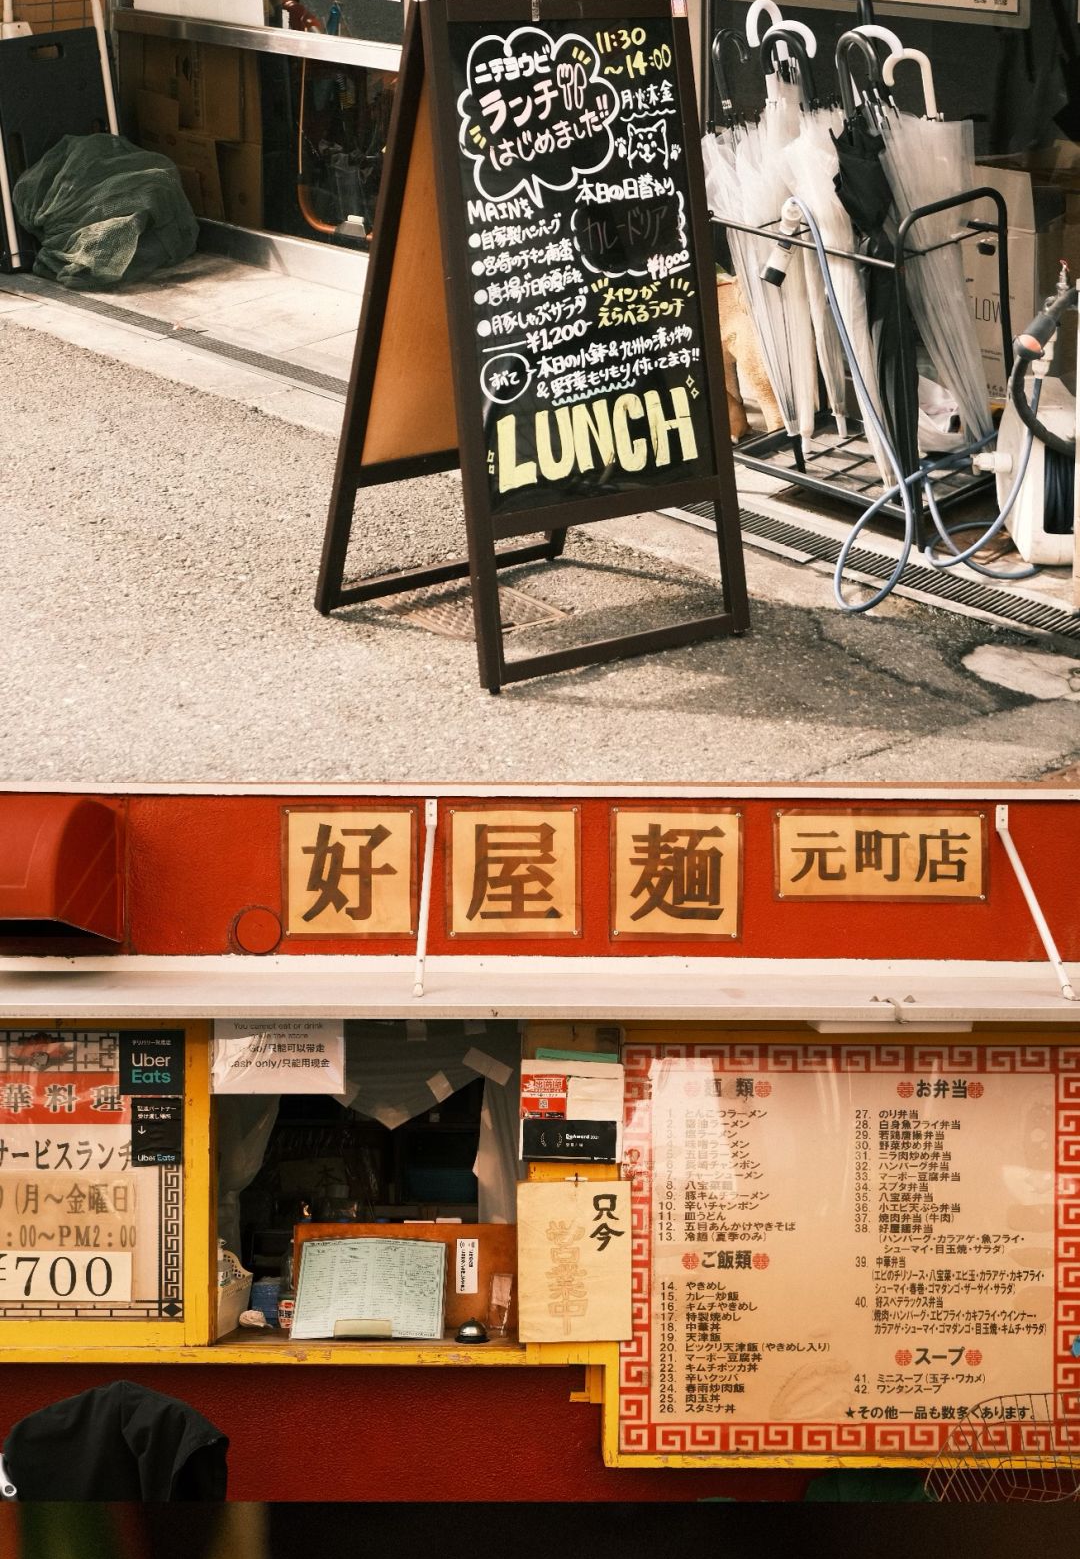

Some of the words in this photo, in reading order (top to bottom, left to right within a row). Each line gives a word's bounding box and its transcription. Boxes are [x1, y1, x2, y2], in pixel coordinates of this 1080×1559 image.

[595, 27, 646, 54] 11:30
[474, 44, 551, 85] ニチヨウビ
[479, 79, 558, 135] ランチ
[575, 173, 675, 206] 本日の日替わり
[467, 198, 522, 225] MAIN
[582, 206, 668, 255] カレードリア
[484, 237, 575, 277] 宮崎のチキン南蛮
[487, 264, 584, 307] 唐揚げ日向夏だれ
[602, 281, 663, 306] メインが
[491, 285, 589, 336] 豚しゃぶサラダ
[597, 297, 686, 329] えらべるランチ
[497, 386, 699, 494] LUNCH
[790, 829, 973, 883] 元町店
[250, 1022, 276, 1030] cannot
[304, 1022, 323, 1030] drink
[131, 1052, 172, 1067] Uber
[231, 1059, 252, 1068] ash
[256, 1058, 331, 1069] only/只能用现金
[131, 1069, 172, 1084] Eats
[916, 1079, 968, 1099] お弁当
[855, 1110, 871, 1119] 27.
[879, 1110, 919, 1119] のり弁当
[855, 1120, 871, 1130] 28.
[880, 1120, 960, 1130] 白身魚フライ弁当
[855, 1131, 871, 1140] 29.
[855, 1141, 871, 1150] 30.
[879, 1141, 943, 1150] 野菜炒め弁当
[137, 1154, 156, 1162] Uber
[157, 1154, 176, 1162] Eats
[855, 1152, 871, 1161] 31.
[879, 1152, 951, 1161] ニラ肉炒め弁当
[855, 1162, 871, 1171] 32.
[879, 1162, 949, 1171] ハンバーグ弁当
[855, 1172, 871, 1182] 33.
[880, 1172, 960, 1182] マーボー豆腐弁当
[855, 1183, 871, 1192] 34.
[879, 1183, 929, 1192] スブタ弁当
[855, 1193, 871, 1202] 35.
[879, 1193, 933, 1202] 八宝菜弁当
[658, 1202, 676, 1210] 10.
[855, 1203, 871, 1213] 36.
[658, 1212, 676, 1220] 11.
[685, 1212, 726, 1220] 皿うどん
[855, 1214, 871, 1223] 37.
[589, 1193, 626, 1252] 只今
[658, 1222, 676, 1231] 12.
[685, 1222, 795, 1231] 五目あんかけやきそば
[855, 1224, 871, 1233] 38.
[658, 1233, 676, 1241] 13.
[701, 1250, 752, 1269] ご飯類
[855, 1257, 868, 1268] 39.
[875, 1257, 906, 1268] 中華弁当
[660, 1282, 677, 1290] 14.
[686, 1282, 726, 1290] やきめし
[660, 1292, 677, 1301] 15.
[855, 1296, 868, 1308] 40.
[660, 1303, 677, 1311] 16.
[686, 1303, 758, 1311] キムチやきめし
[660, 1313, 677, 1321] 17.
[686, 1313, 741, 1321] 特製焼めし
[660, 1323, 677, 1332] 18.
[686, 1323, 721, 1332] 中華丼
[660, 1333, 677, 1342] 19.
[686, 1333, 720, 1342] 天津飯
[660, 1343, 677, 1352] 20.
[660, 1353, 677, 1362] 21.
[686, 1353, 762, 1362] マーボー豆腐丼
[914, 1347, 965, 1366] スープ
[660, 1364, 677, 1372] 22.
[660, 1374, 677, 1382] 23.
[855, 1373, 870, 1383] 41.
[660, 1384, 677, 1393] 24.
[854, 1384, 870, 1394] 42.
[877, 1384, 942, 1394] ワンタンスープ
[660, 1394, 677, 1403] 25.
[685, 1394, 720, 1403] 肉玉丼
[660, 1404, 677, 1413] 26.
[685, 1404, 736, 1413] スタミナ丼
